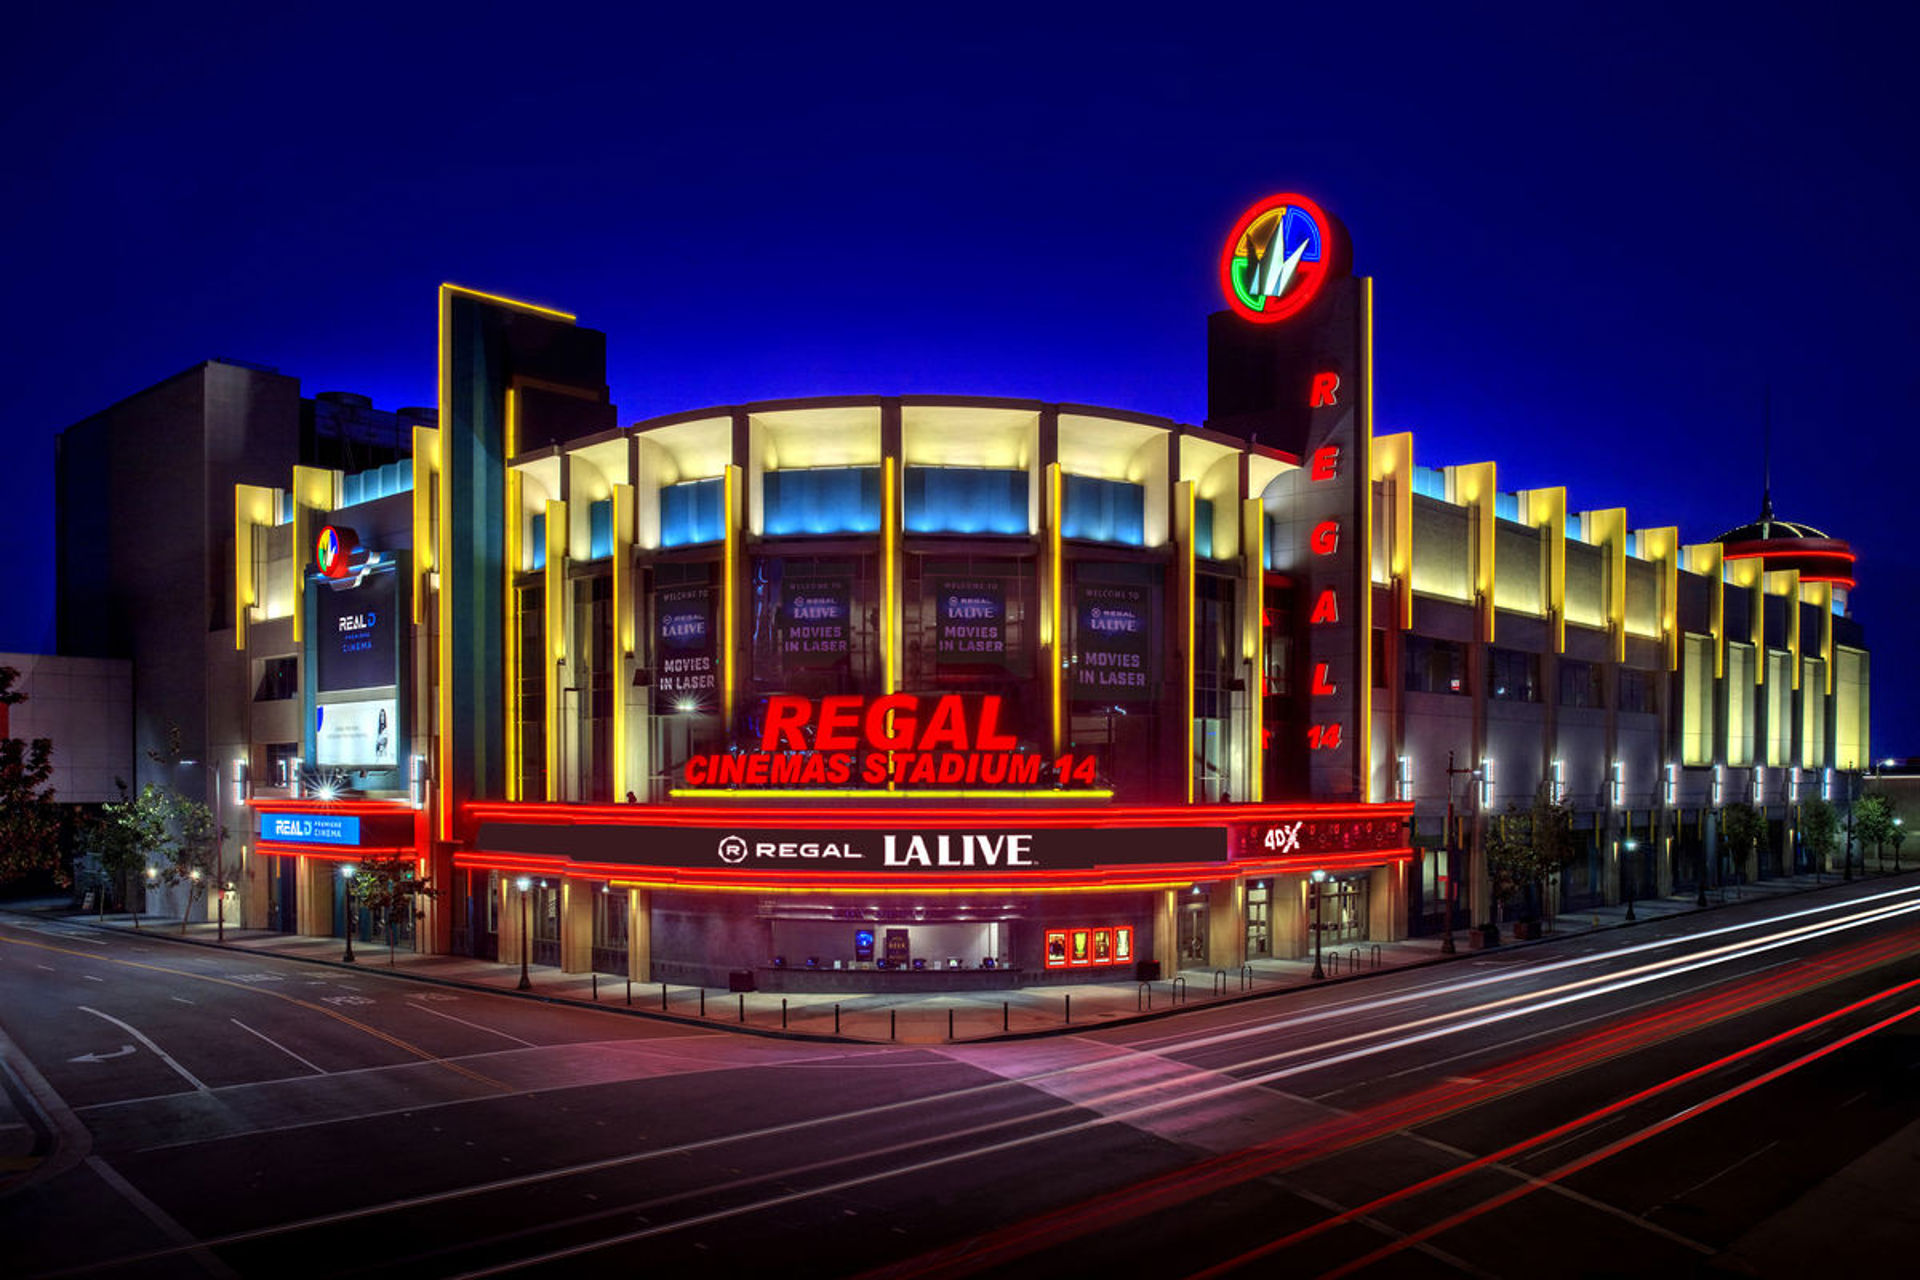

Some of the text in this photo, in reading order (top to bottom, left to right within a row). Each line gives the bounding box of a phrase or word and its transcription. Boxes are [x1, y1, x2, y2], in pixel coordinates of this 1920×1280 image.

[1309, 371, 1340, 694] REGAL
[790, 626, 842, 638] MOVIES
[945, 626, 998, 638] MOVIES
[785, 641, 847, 652] IN LASER
[939, 640, 1004, 652] IN LASER
[665, 657, 710, 673] MOVIES
[1085, 652, 1140, 668] MOVIES
[660, 675, 715, 691] IN LASER
[1080, 670, 1145, 686] IN LASER
[761, 693, 1018, 752] REGAL
[1307, 724, 1343, 750] 14
[684, 753, 1097, 785] CINEMAS STADIUM 14
[314, 828, 342, 838] CINEMA
[756, 843, 863, 858] REGAL
